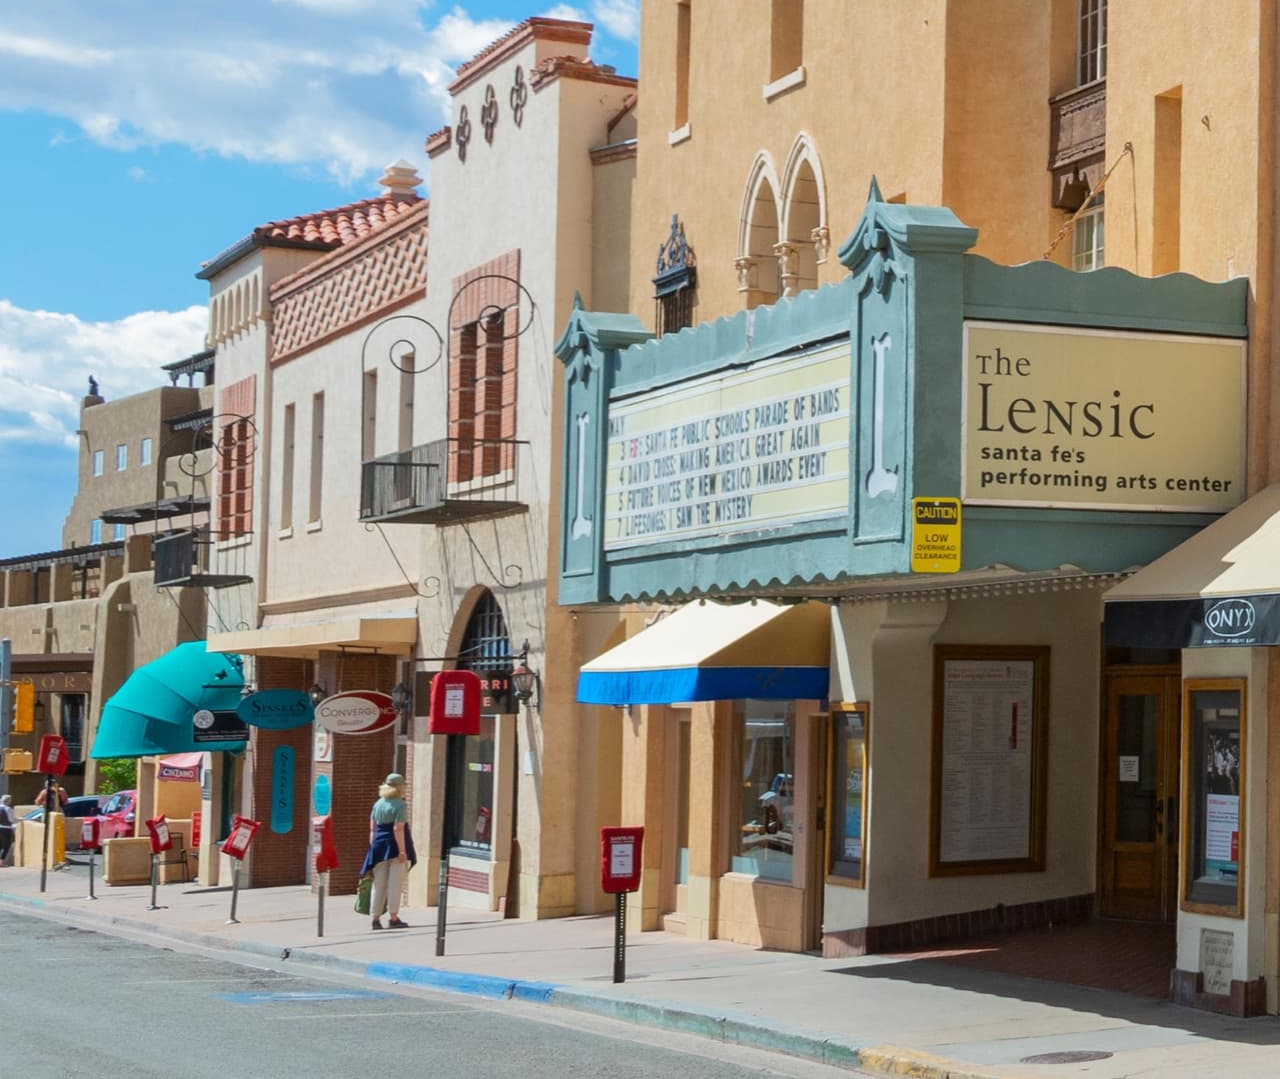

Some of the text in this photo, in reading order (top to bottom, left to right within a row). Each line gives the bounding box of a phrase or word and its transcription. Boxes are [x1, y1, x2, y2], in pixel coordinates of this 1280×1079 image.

[975, 348, 1031, 376] The
[645, 429, 667, 455] SANTA
[670, 427, 678, 450] FE
[682, 419, 710, 446] PUBLIC
[715, 410, 750, 439] SCHOOLS
[754, 401, 788, 429] PARADE
[794, 396, 805, 421] OF
[810, 387, 840, 417] BANDS
[628, 461, 650, 485] DAVID
[680, 446, 710, 473] MAKING
[715, 438, 750, 467] AMERICA
[755, 430, 784, 458] GREAT
[790, 423, 820, 452] AGAIN
[981, 445, 1085, 463] santa fe's
[627, 487, 654, 511] FUTURE
[657, 479, 681, 506] VOICES
[685, 477, 695, 500] OF
[699, 473, 717, 497] NEW
[721, 466, 752, 494] MEXICO
[757, 458, 793, 487] AWARDS
[798, 452, 827, 480] EVENT
[981, 468, 1232, 492] performing arts center
[677, 504, 692, 528] SAW
[696, 502, 710, 526] THE
[715, 494, 753, 522] MYSTERY
[916, 506, 957, 519] CAUTION
[916, 544, 957, 552] OVERHEAD
[925, 534, 949, 543] LOW
[914, 552, 958, 560] CLEARANCE
[1208, 607, 1252, 628] ONYX
